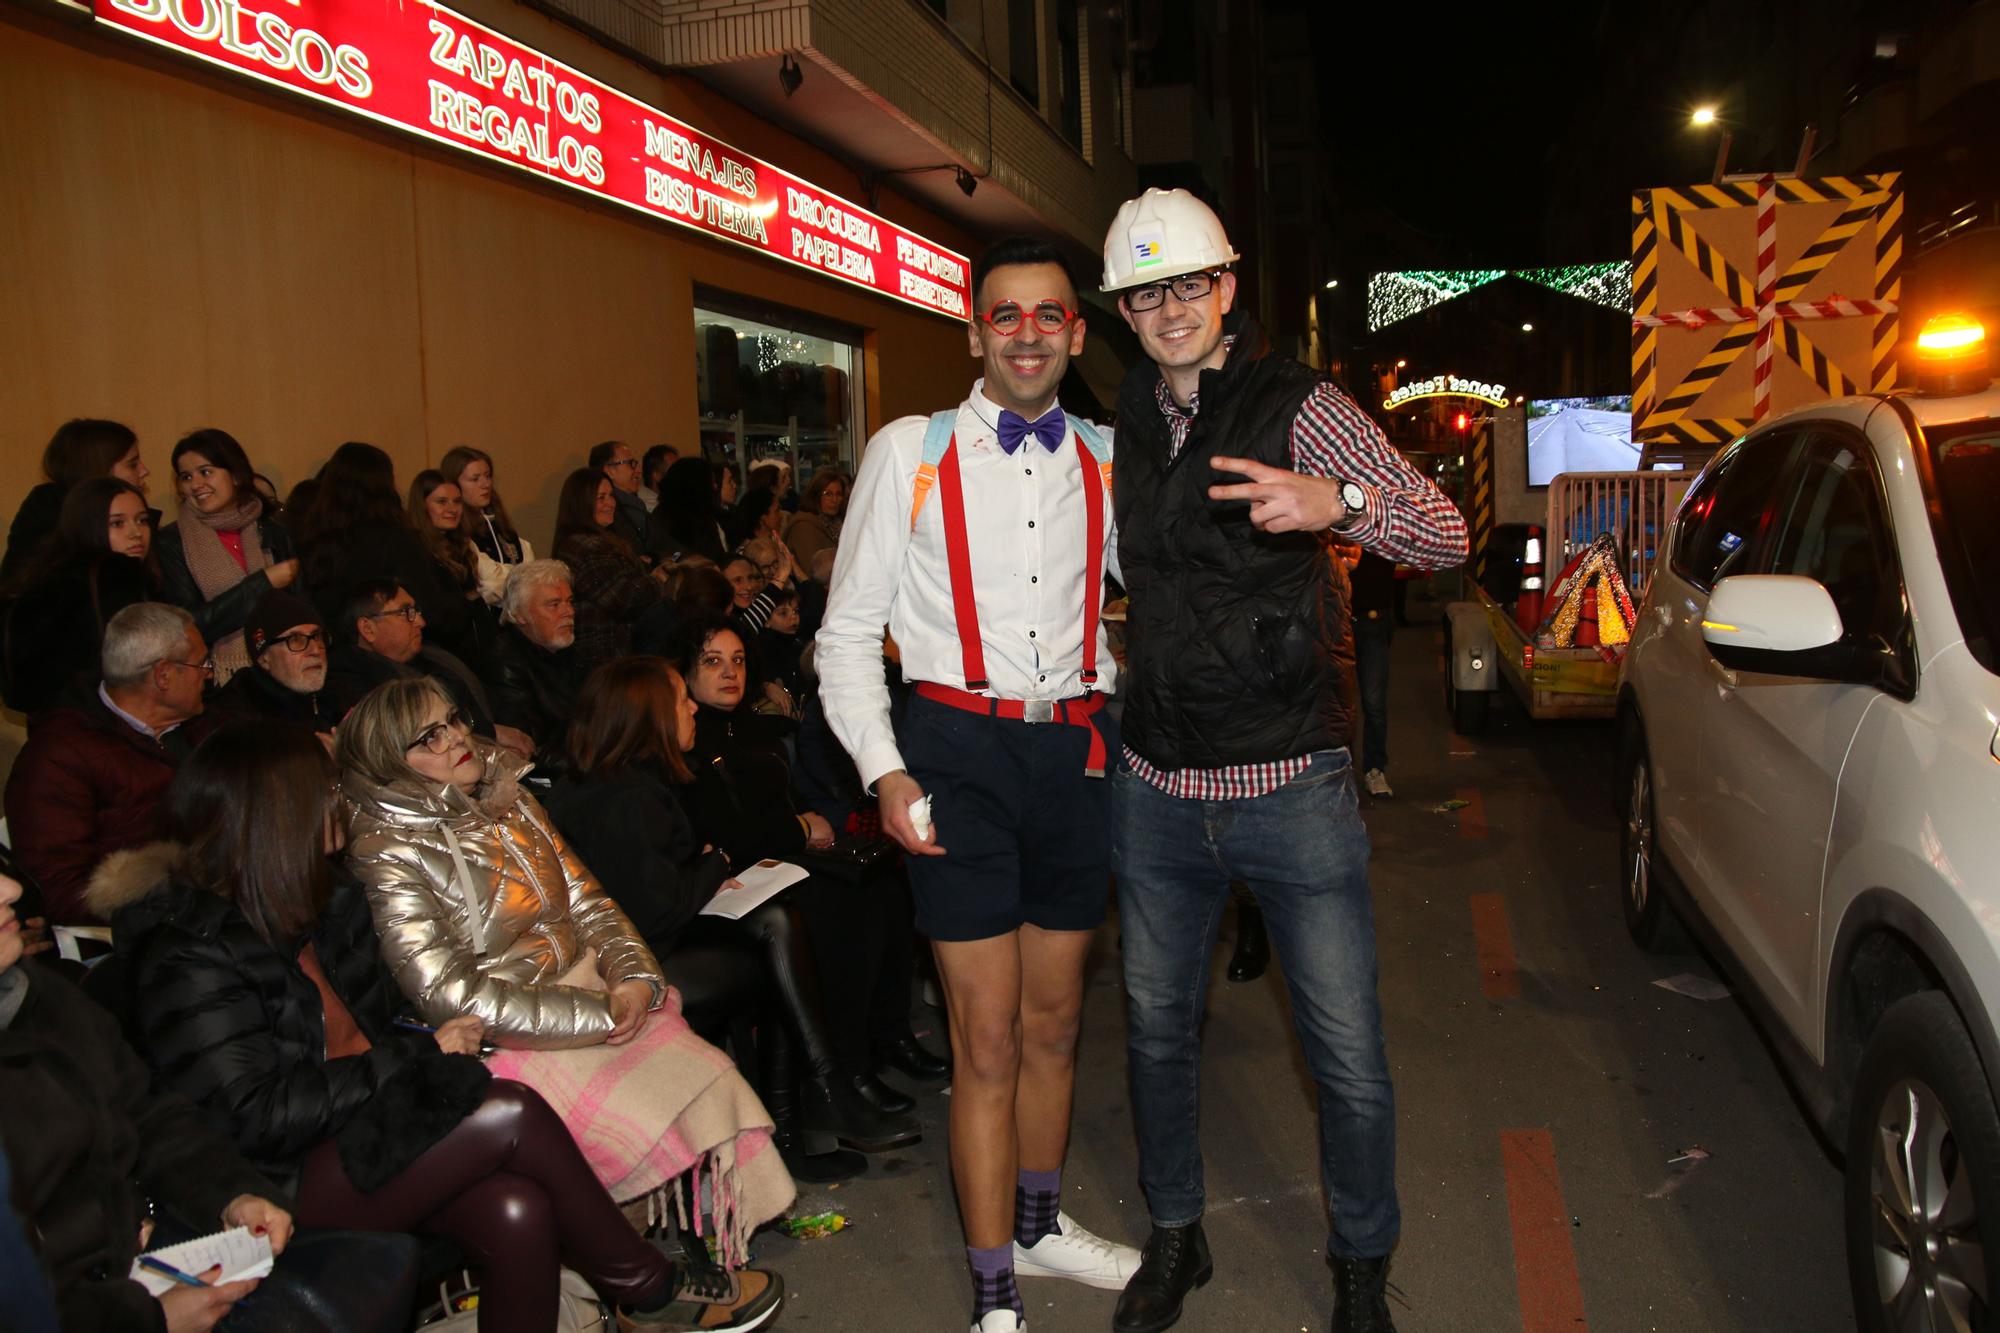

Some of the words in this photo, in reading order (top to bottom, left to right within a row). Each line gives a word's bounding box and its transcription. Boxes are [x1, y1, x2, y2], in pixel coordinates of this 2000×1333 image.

[428, 19, 601, 133] ZAPATOS
[428, 79, 605, 185] REGALOS
[644, 119, 757, 198] MENAJES
[645, 167, 768, 245] BISUTERIA
[787, 187, 881, 253] DROGUERIA
[792, 227, 876, 284] PAPELERIA
[896, 235, 965, 288] PERFUMERIA
[899, 268, 965, 316] FERRETERIA
